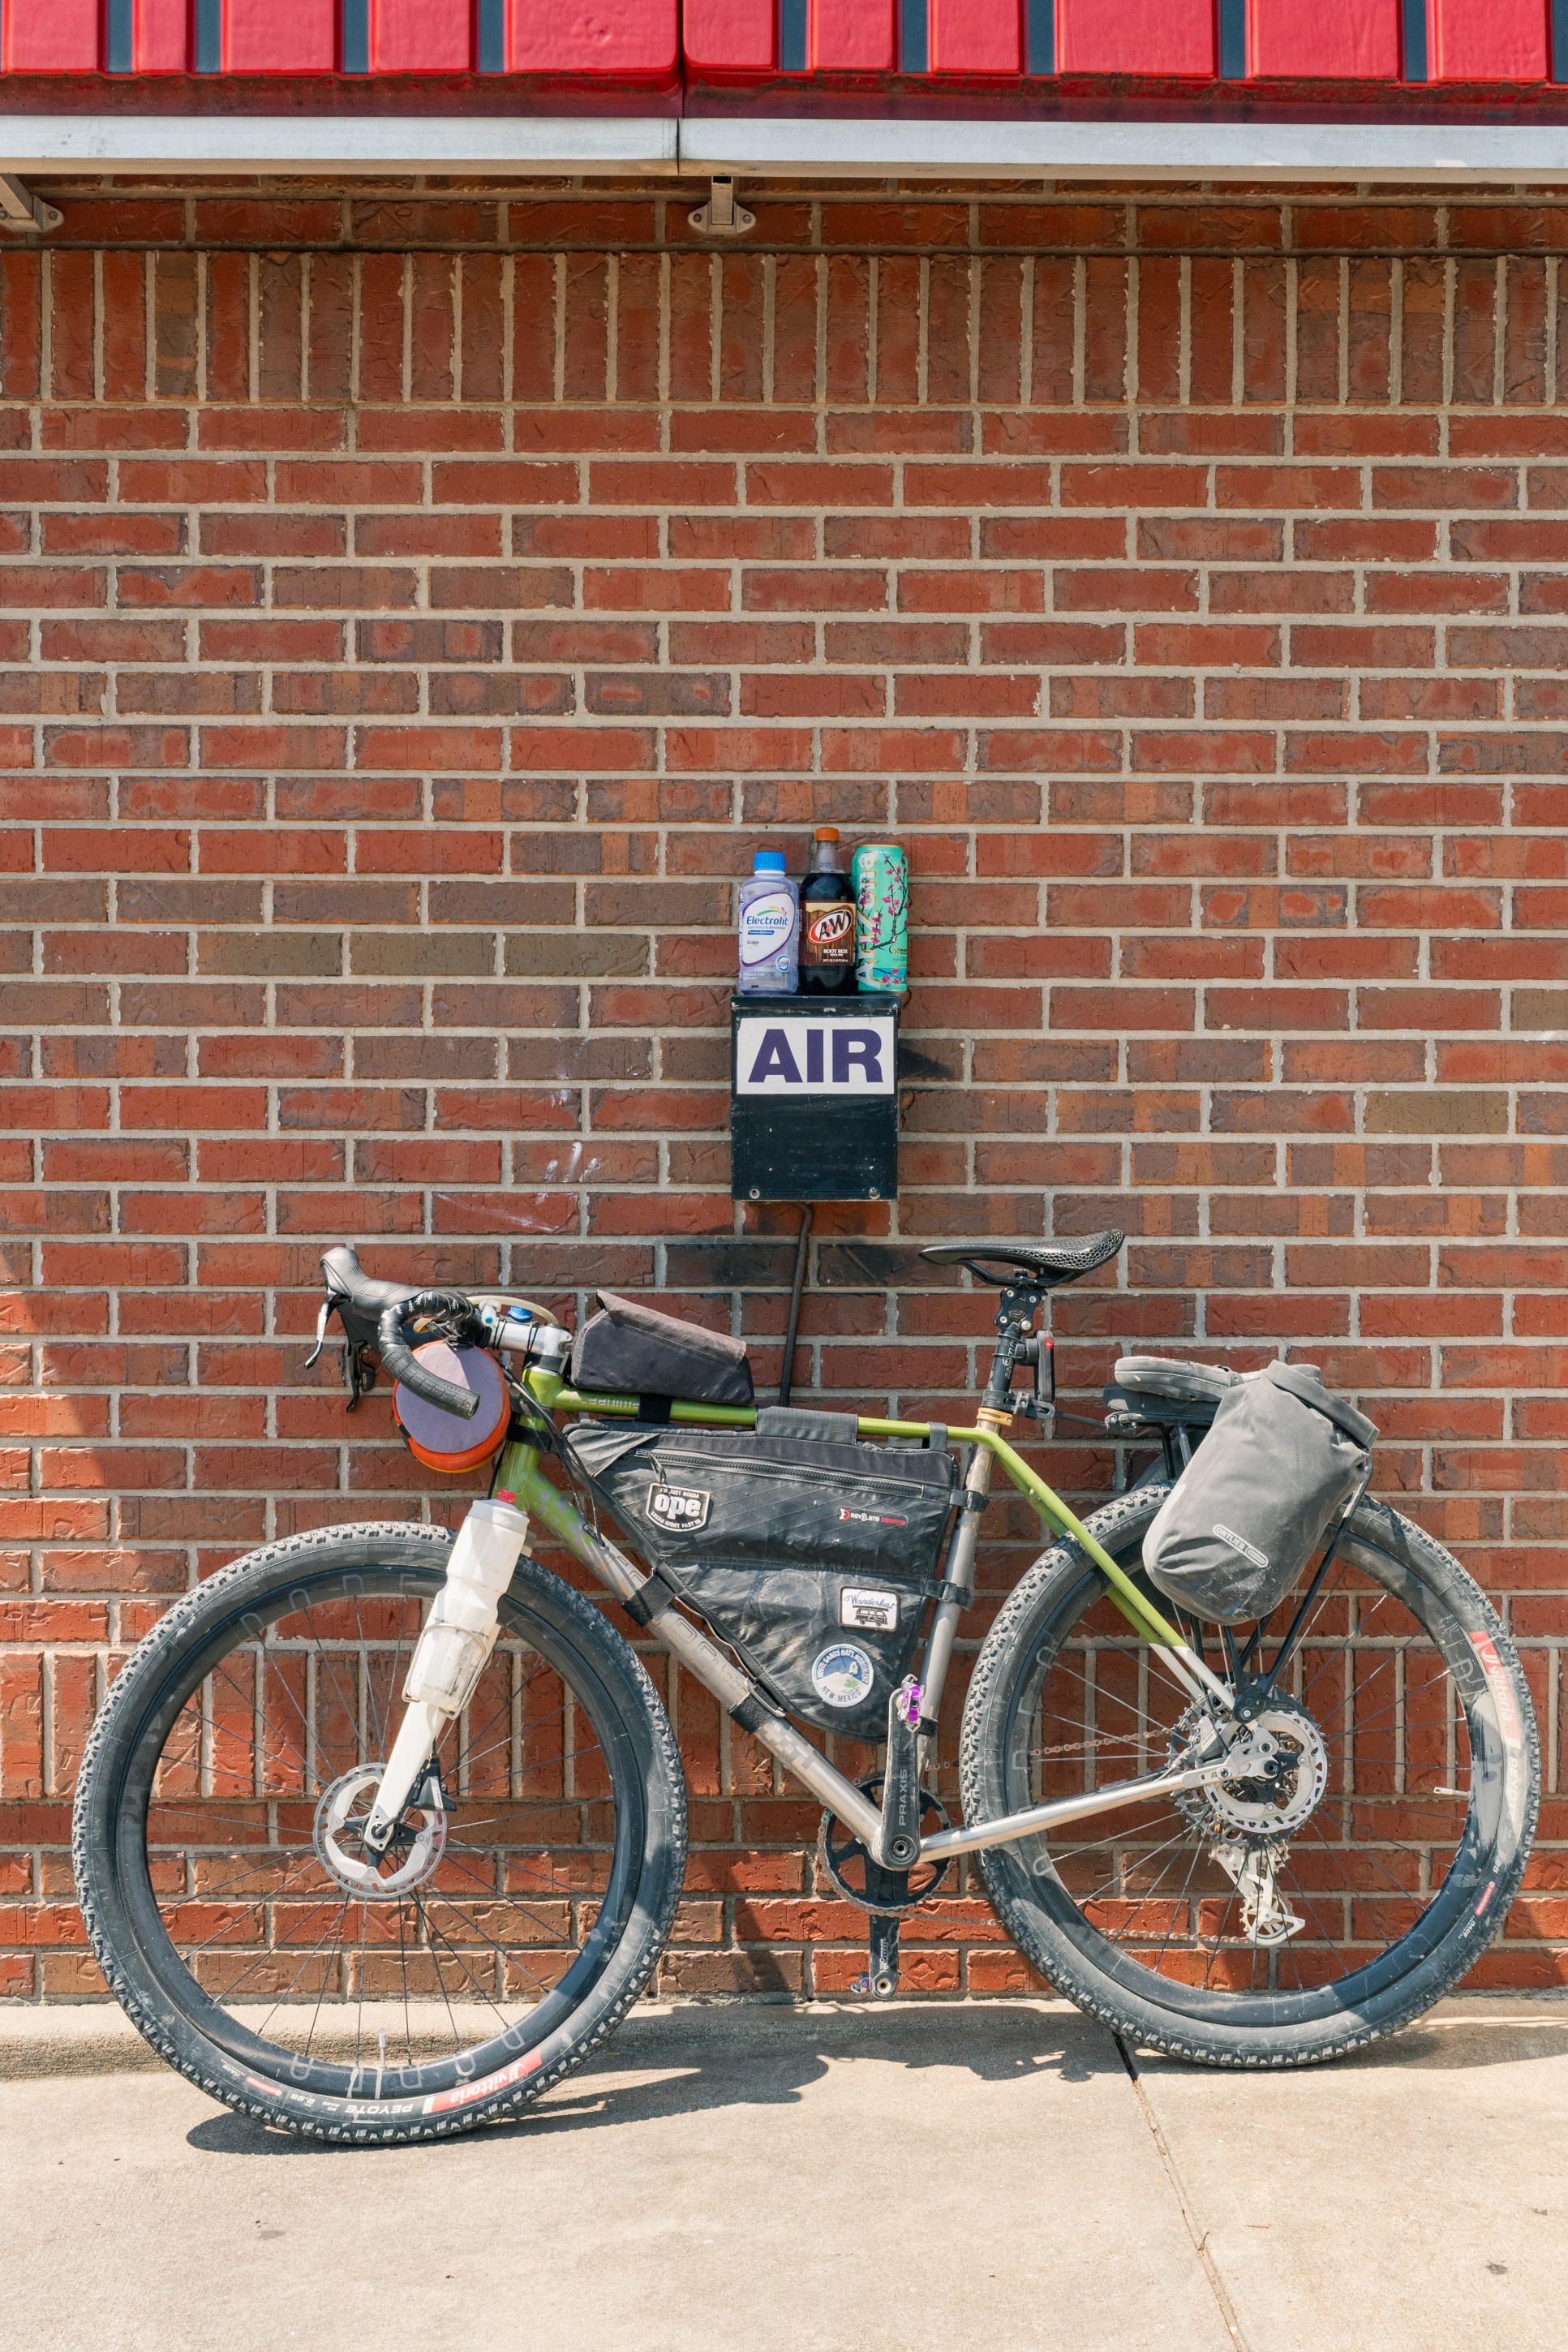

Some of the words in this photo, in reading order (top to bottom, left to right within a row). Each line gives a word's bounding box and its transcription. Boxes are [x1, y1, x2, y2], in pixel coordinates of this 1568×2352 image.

[746, 915, 788, 926] Electrolit
[818, 910, 847, 942] A&W
[747, 1029, 883, 1083] AIR
[654, 1494, 702, 1520] ope
[650, 1511, 665, 1524] SNEAK
[665, 1520, 680, 1528] RIGHT
[1216, 1527, 1246, 1550] ORTLIEB
[844, 1590, 896, 1609] Wanderlust
[817, 1662, 826, 1679] WHITE
[823, 1649, 840, 1663] SANDS
[822, 1685, 836, 1700] NEW
[837, 1688, 861, 1702] MEXICO
[899, 1769, 908, 1826] PRAXIS
[449, 2075, 508, 2105] vittoria
[345, 2104, 414, 2114] PEYOTE
